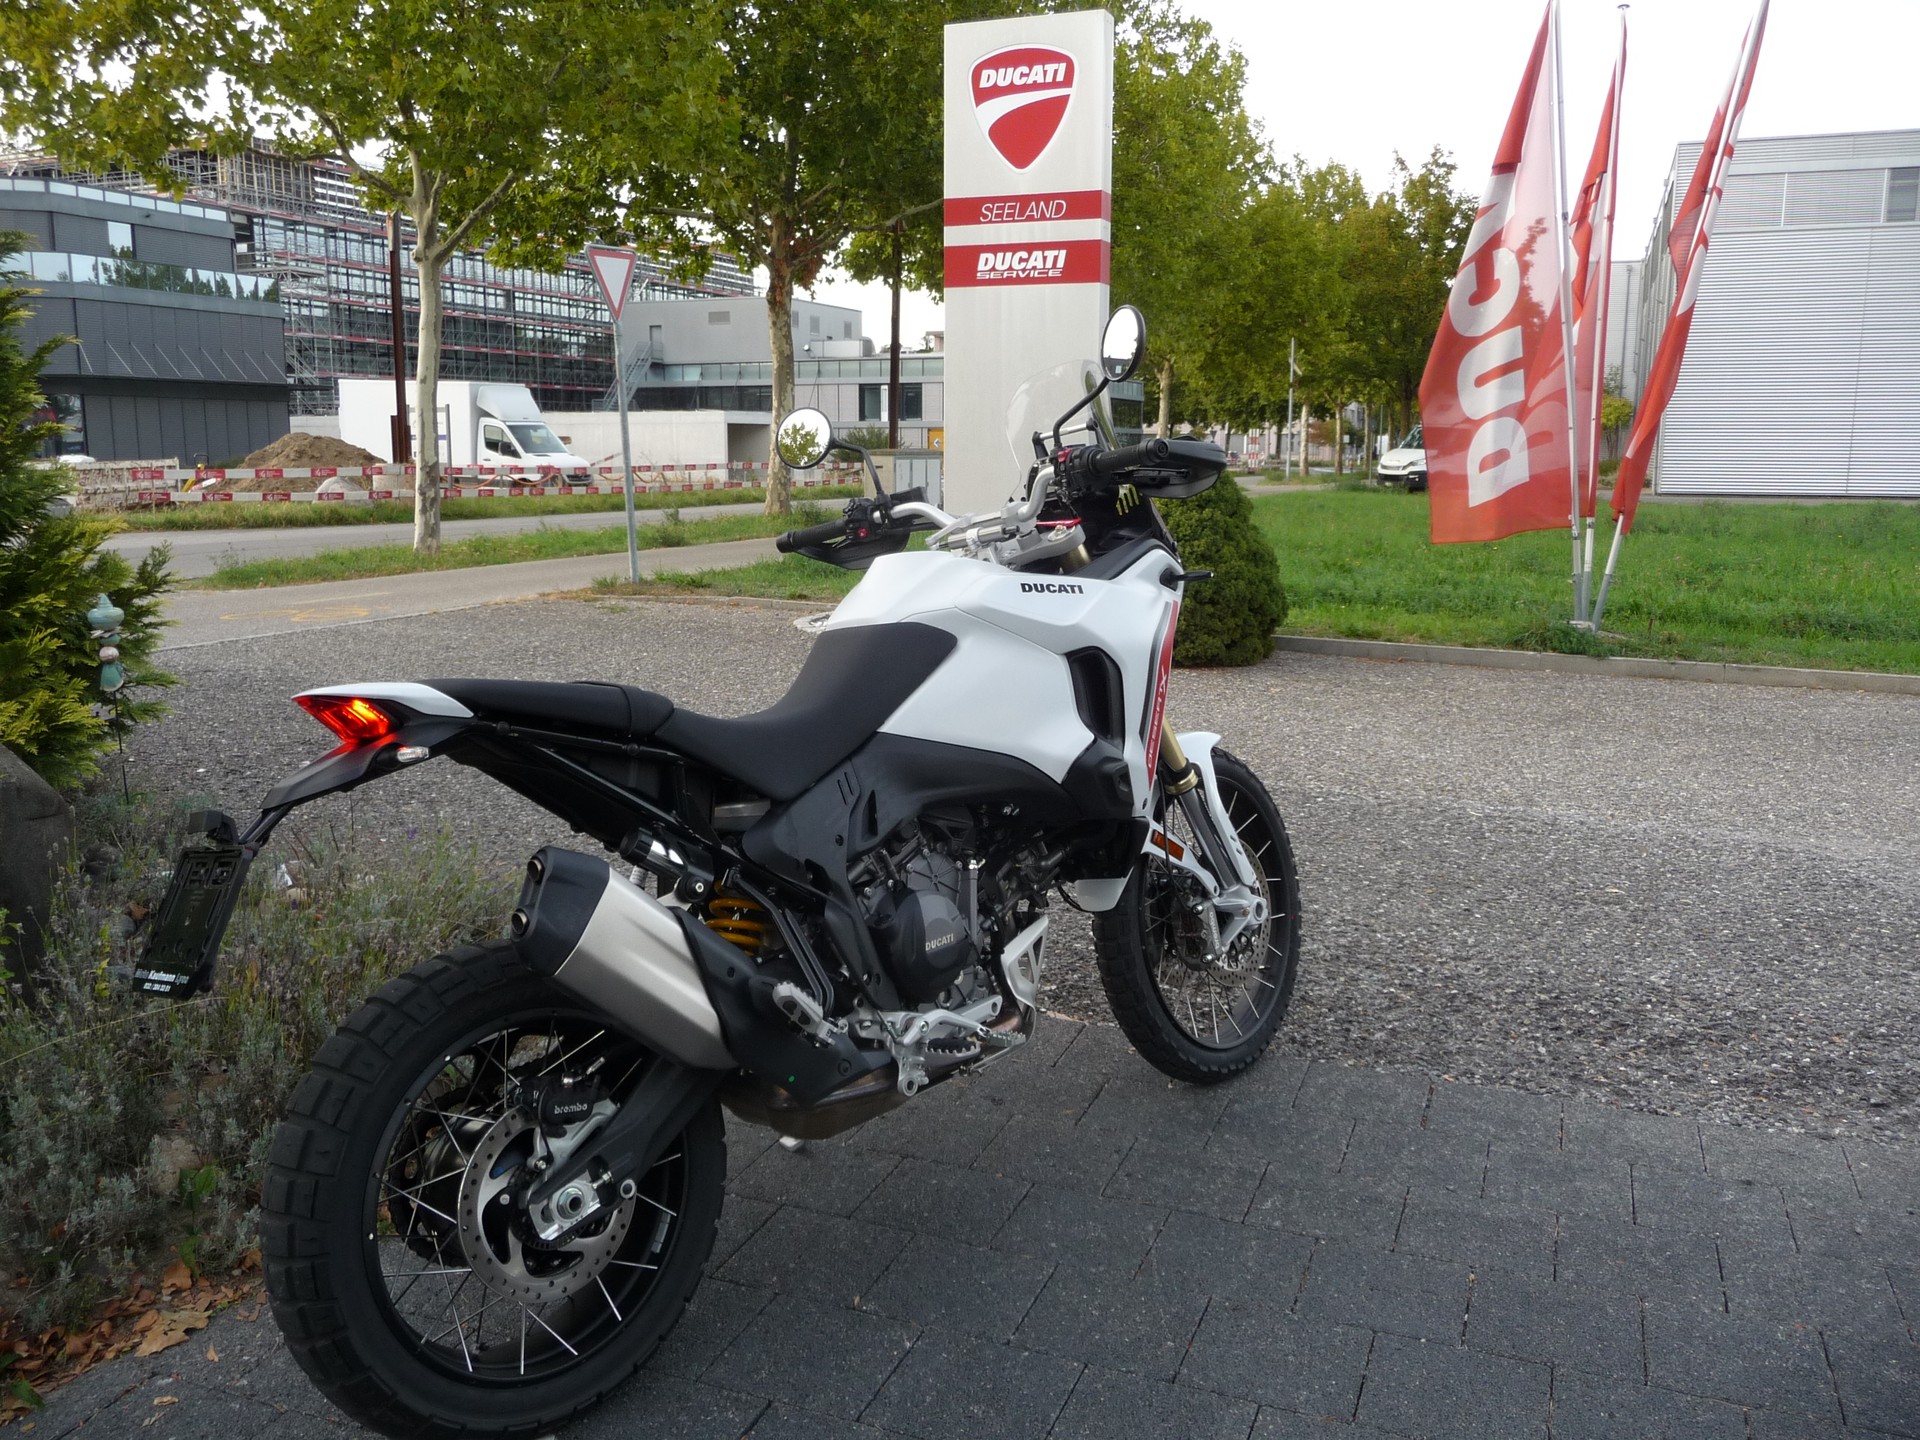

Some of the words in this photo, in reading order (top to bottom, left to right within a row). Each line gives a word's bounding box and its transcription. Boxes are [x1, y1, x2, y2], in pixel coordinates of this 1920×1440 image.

[979, 63, 1066, 88] DUCATI
[980, 200, 1066, 222] SEELAND
[977, 250, 1066, 271] DUCATI
[976, 269, 1062, 279] SERVICE
[1020, 583, 1084, 595] DUCATI
[925, 933, 954, 951] DUCATI
[554, 1102, 588, 1115] brembo
